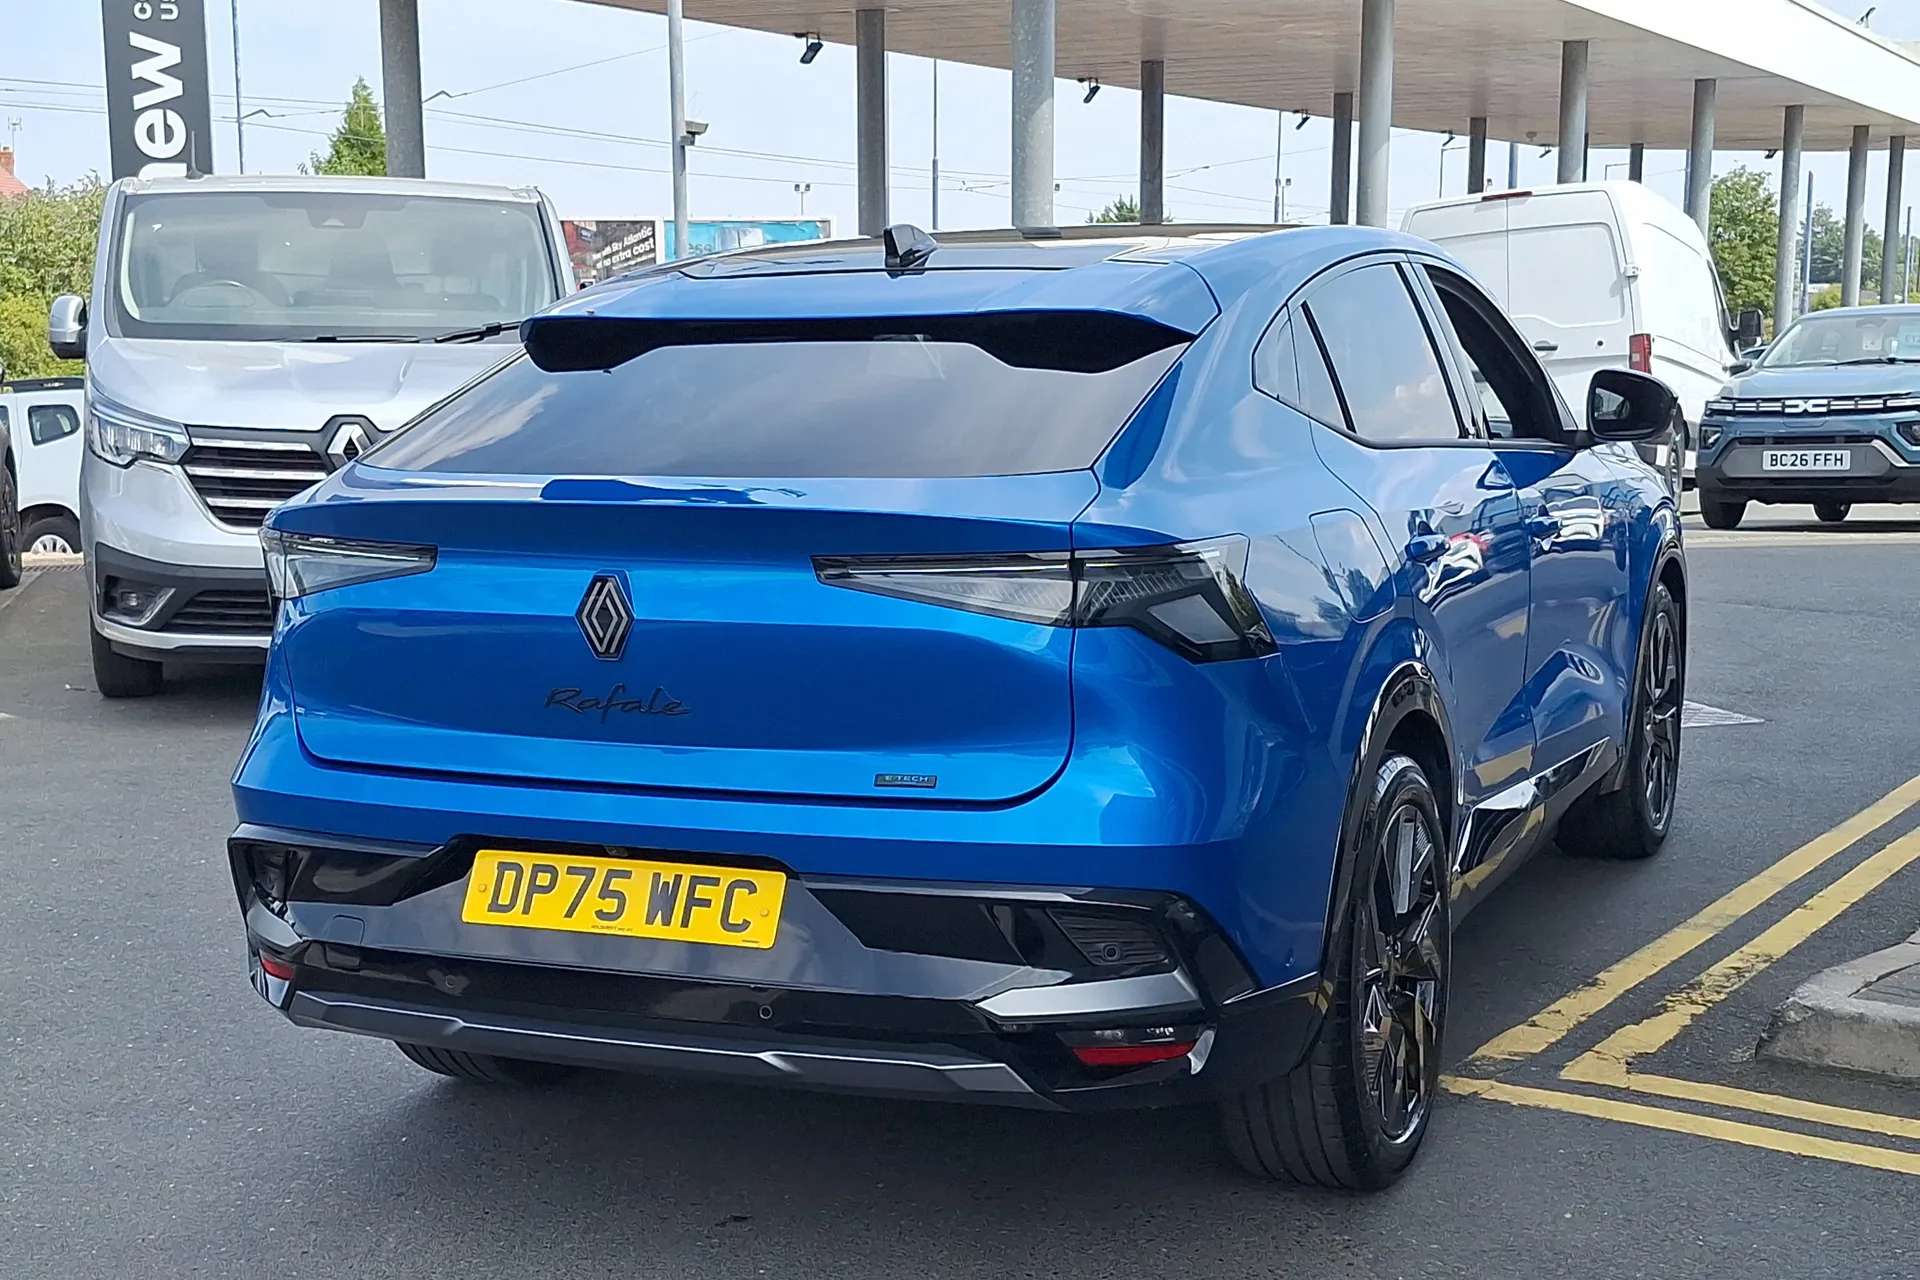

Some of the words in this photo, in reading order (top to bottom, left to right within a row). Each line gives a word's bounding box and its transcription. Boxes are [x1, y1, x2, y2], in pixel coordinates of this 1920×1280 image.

[623, 226, 653, 247] Atlantic
[612, 248, 632, 264] extra
[632, 237, 655, 255] cost
[1769, 453, 1808, 467] BC26
[1813, 453, 1844, 467] FFH
[544, 682, 691, 725] Rafale
[487, 861, 632, 922] DP75
[645, 872, 757, 934] WFC
